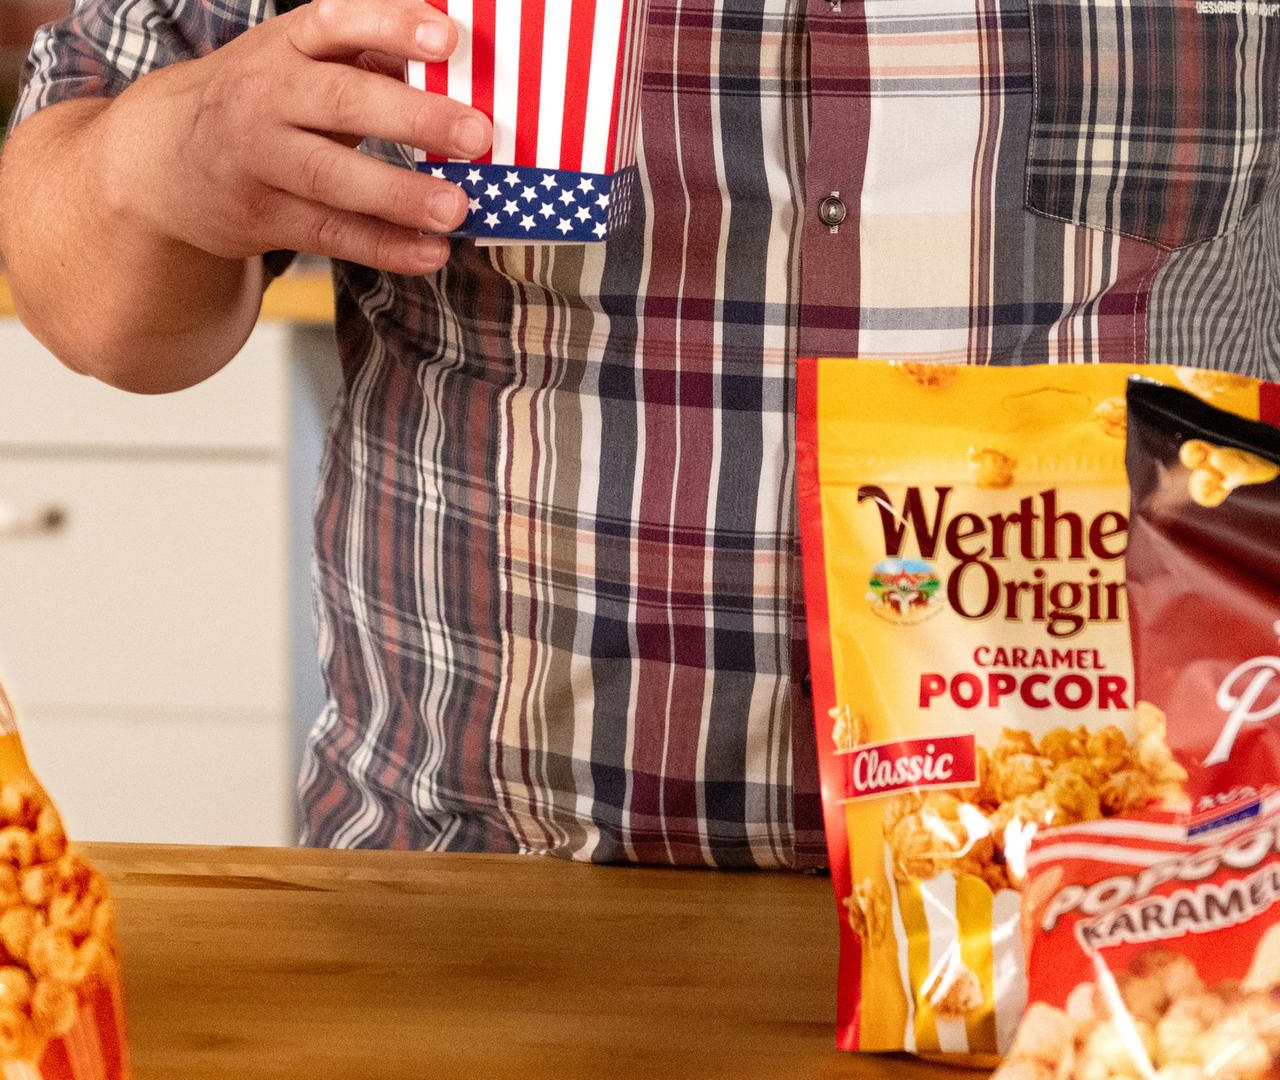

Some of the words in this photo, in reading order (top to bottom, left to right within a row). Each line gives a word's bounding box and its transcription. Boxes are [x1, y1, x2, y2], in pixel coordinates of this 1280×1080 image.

[857, 484, 1129, 562] Werthe
[972, 646, 1106, 670] CARAMEL
[918, 672, 1129, 711] POPCOR
[853, 742, 955, 792] Classic
